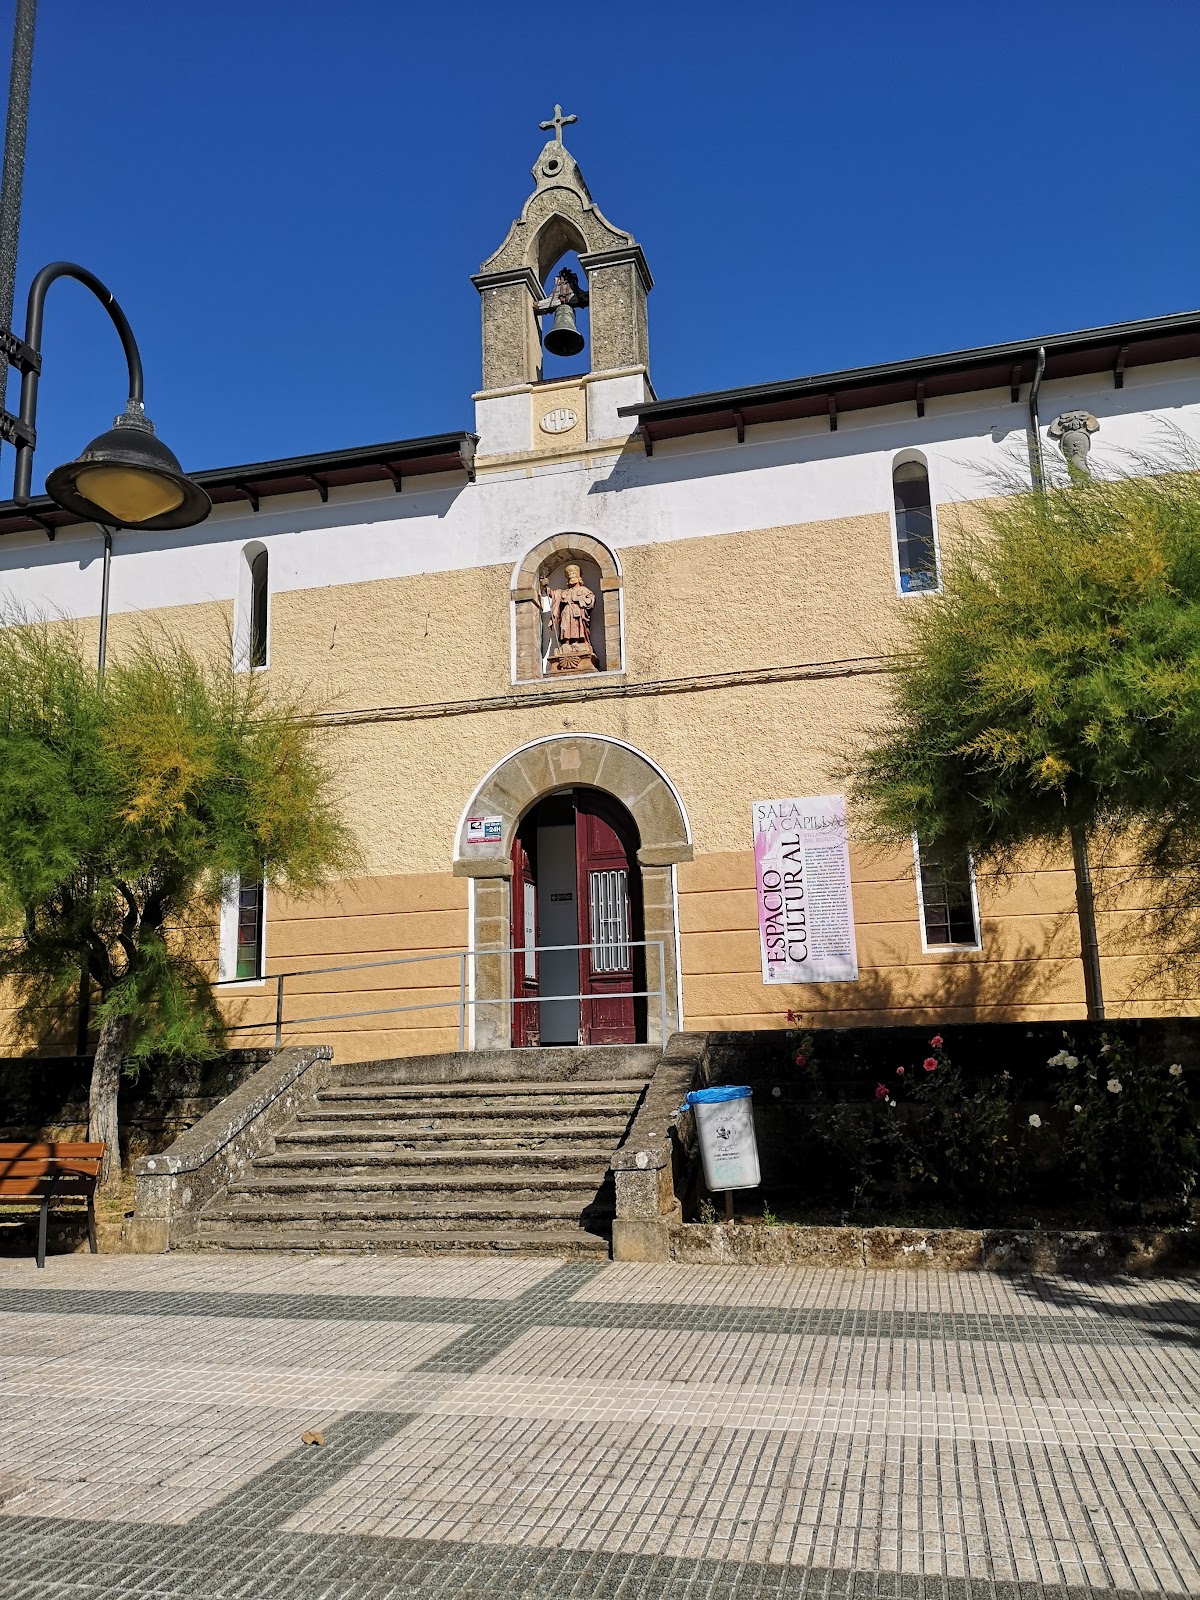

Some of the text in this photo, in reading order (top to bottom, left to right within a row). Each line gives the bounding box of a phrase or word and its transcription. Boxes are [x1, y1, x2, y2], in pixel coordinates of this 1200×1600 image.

[757, 803, 801, 820] SALA
[758, 814, 843, 833] LA CAPILLA
[762, 869, 787, 964] ESPACIO
[781, 833, 809, 963] CULTURAL
